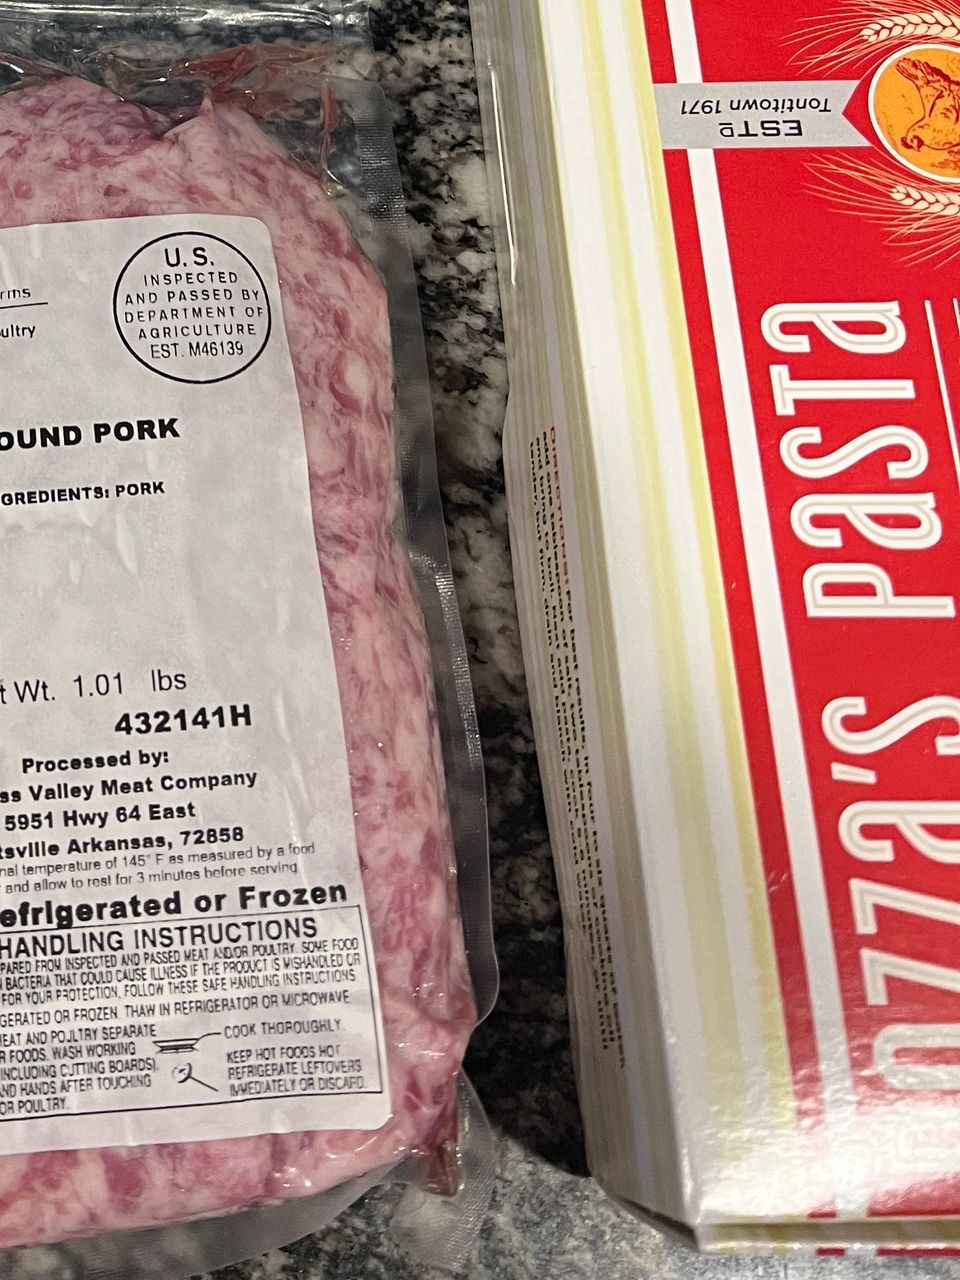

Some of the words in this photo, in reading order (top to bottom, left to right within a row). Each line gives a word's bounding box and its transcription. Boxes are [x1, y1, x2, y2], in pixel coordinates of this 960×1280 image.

[680, 97, 723, 115] 1971
[729, 96, 833, 113] Tontitown
[143, 271, 237, 286] INSPECTED
[125, 292, 157, 305] AND
[167, 288, 232, 302] PASSED
[241, 288, 258, 300] BY
[124, 305, 234, 323] DEPARTMENT
[244, 306, 263, 317] OF
[138, 323, 256, 340] AGRICULTURE
[150, 342, 184, 358] EST.
[188, 340, 243, 356] M46139
[93, 417, 180, 443] PORK
[115, 481, 164, 497] PORK
[13, 679, 55, 703] Wt.
[73, 672, 122, 697] 1.01
[151, 668, 186, 691] lbs
[114, 703, 251, 735] 432141H
[22, 750, 130, 773] Processed
[138, 749, 168, 767] by:
[28, 782, 93, 801] Valley
[101, 777, 153, 795] Meat
[160, 772, 256, 790] Company
[4, 811, 53, 831] 5951
[62, 809, 108, 828] Hwy
[115, 804, 141, 822] 64
[148, 801, 195, 820] East
[67, 835, 172, 854] Arkansas,
[179, 826, 243, 845] 72858
[21, 860, 101, 876] temperature
[105, 855, 117, 869] of
[155, 852, 164, 864] F
[168, 854, 183, 864] as
[187, 846, 253, 862] measured
[256, 845, 272, 860] by
[276, 846, 284, 856] a
[288, 841, 315, 854] food
[5, 879, 29, 894] and
[33, 878, 67, 891] allow
[70, 876, 83, 888] to
[87, 874, 111, 887] rest
[115, 872, 132, 885] for
[136, 871, 144, 883] 3
[148, 868, 200, 882] minutes
[203, 864, 245, 878] before
[194, 893, 226, 912] or
[238, 884, 346, 909] Frozen
[134, 917, 317, 949] INSTRUCTIONS
[54, 1009, 69, 1023] OR
[124, 1003, 155, 1017] THAW
[159, 1002, 170, 1015] IN
[173, 995, 258, 1015] REFRIGERATOR
[261, 994, 278, 1009] OR
[25, 1031, 47, 1044] AND
[50, 1027, 97, 1043] POULTRY
[101, 1023, 156, 1040] SEPARATE
[223, 1023, 256, 1039] COOK
[51, 1045, 82, 1059] WASH
[85, 1041, 135, 1057] WORKING
[225, 1048, 252, 1064] KEEP
[255, 1046, 275, 1060] HOT
[279, 1045, 316, 1059] FOODS
[60, 1060, 105, 1077] CUTTING
[20, 1080, 56, 1095] HANDS
[60, 1077, 92, 1092] AFTER
[96, 1073, 151, 1090] TOUCHING
